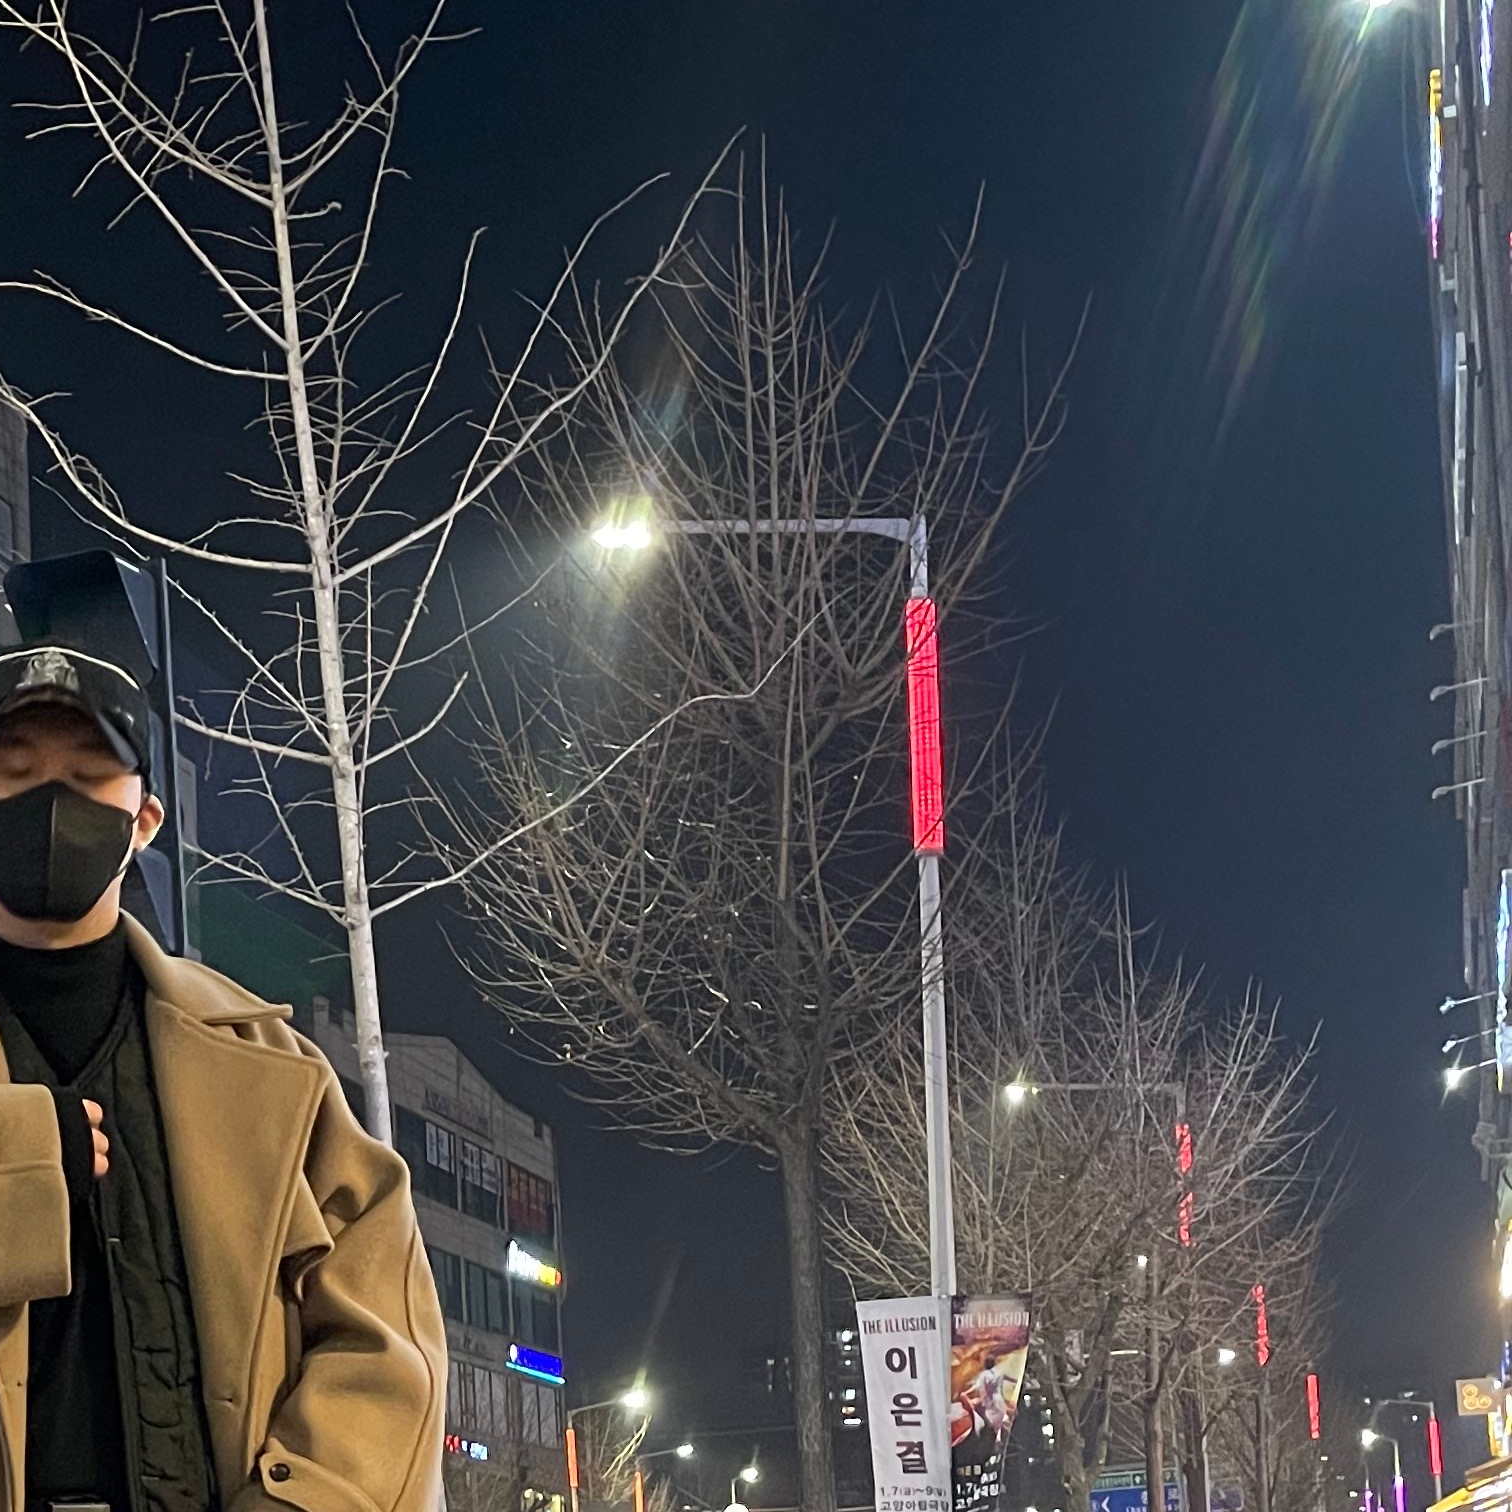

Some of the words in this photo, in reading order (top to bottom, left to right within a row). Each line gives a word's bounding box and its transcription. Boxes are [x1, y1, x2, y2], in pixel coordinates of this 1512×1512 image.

[862, 1320, 882, 1334] THE
[885, 1316, 936, 1333] ILLUSION
[954, 1313, 974, 1328] THE
[884, 1346, 928, 1475] 이은결
